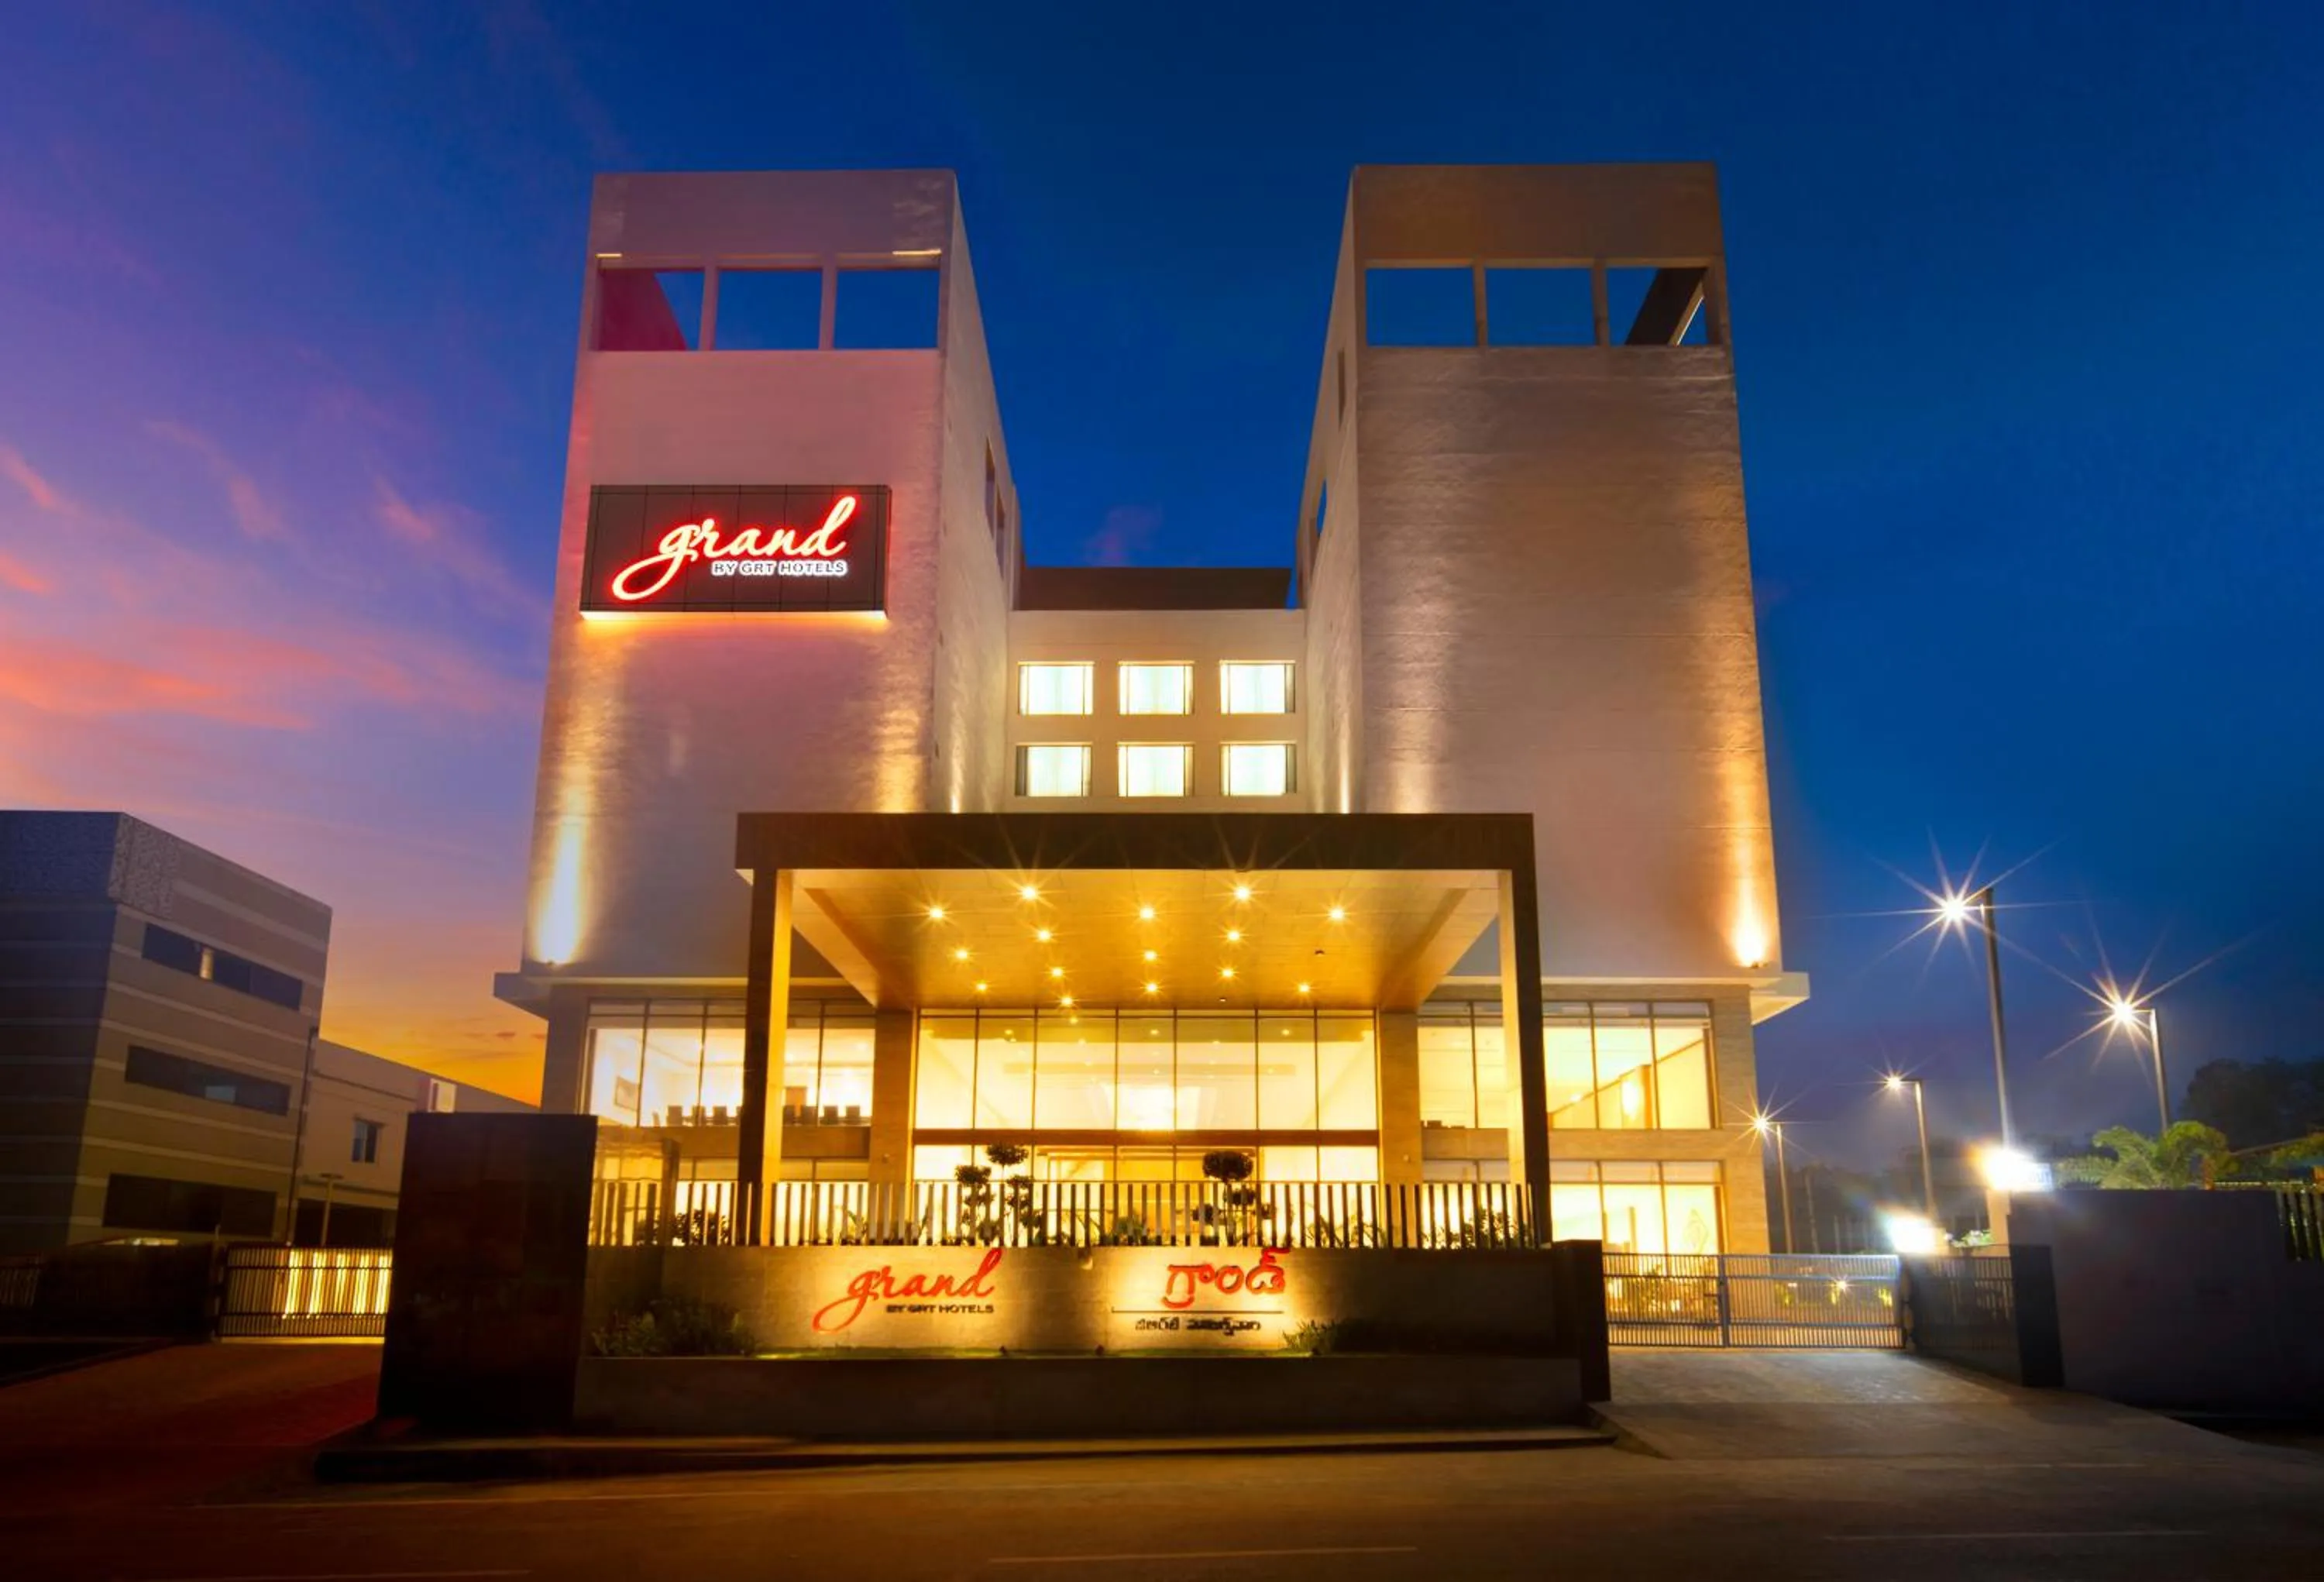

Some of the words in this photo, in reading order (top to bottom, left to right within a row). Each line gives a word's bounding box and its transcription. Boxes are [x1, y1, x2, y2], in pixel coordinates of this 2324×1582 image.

[612, 496, 856, 600] grand
[713, 562, 737, 574] BY
[741, 562, 775, 574] GRT
[779, 562, 846, 574] HOTELS
[812, 1247, 1002, 1333] grand
[939, 1304, 994, 1313] HOTELS
[1161, 1247, 1290, 1309] గ్రాండ్
